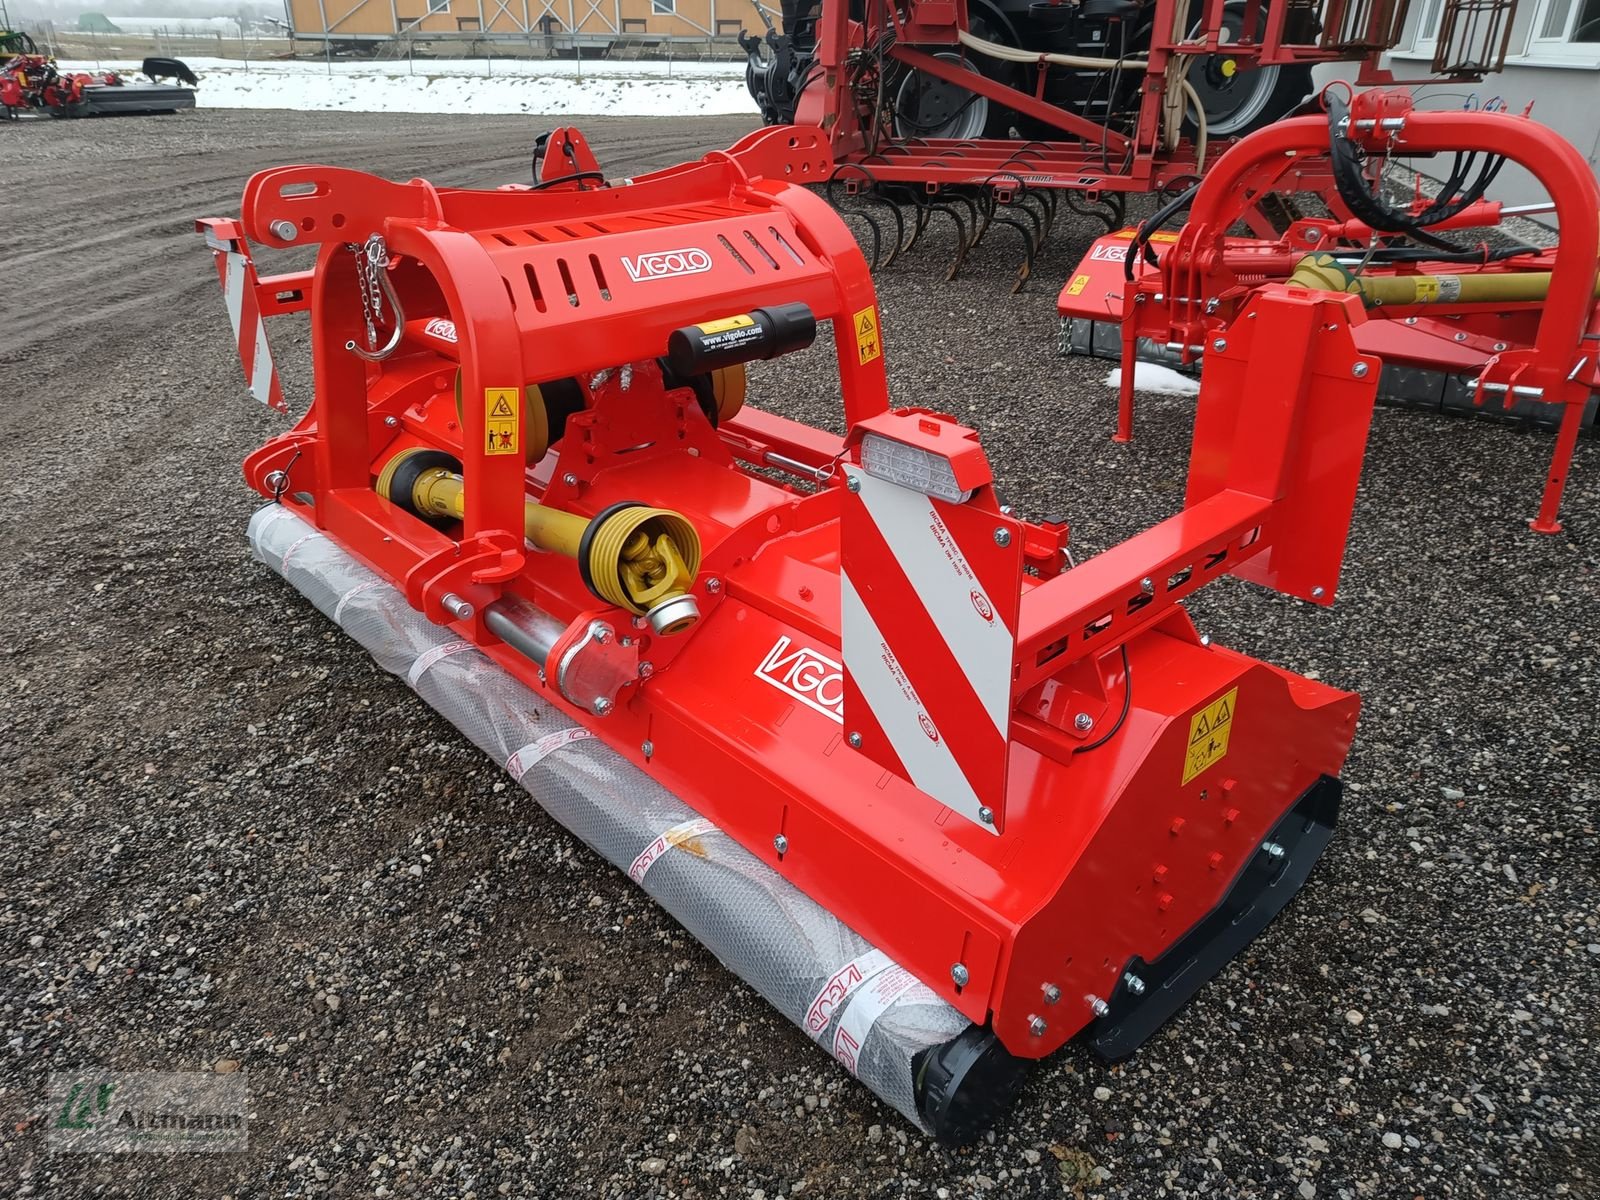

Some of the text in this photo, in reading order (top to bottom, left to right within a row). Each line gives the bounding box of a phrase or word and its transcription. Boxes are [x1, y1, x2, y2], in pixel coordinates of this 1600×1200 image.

[620, 247, 713, 282] VIGOLO
[702, 326, 763, 347] www.vigolo.com
[929, 510, 946, 534] BICMA
[929, 524, 946, 549] BICMA
[753, 634, 843, 725] VIGO
[834, 1026, 860, 1074] VIG
